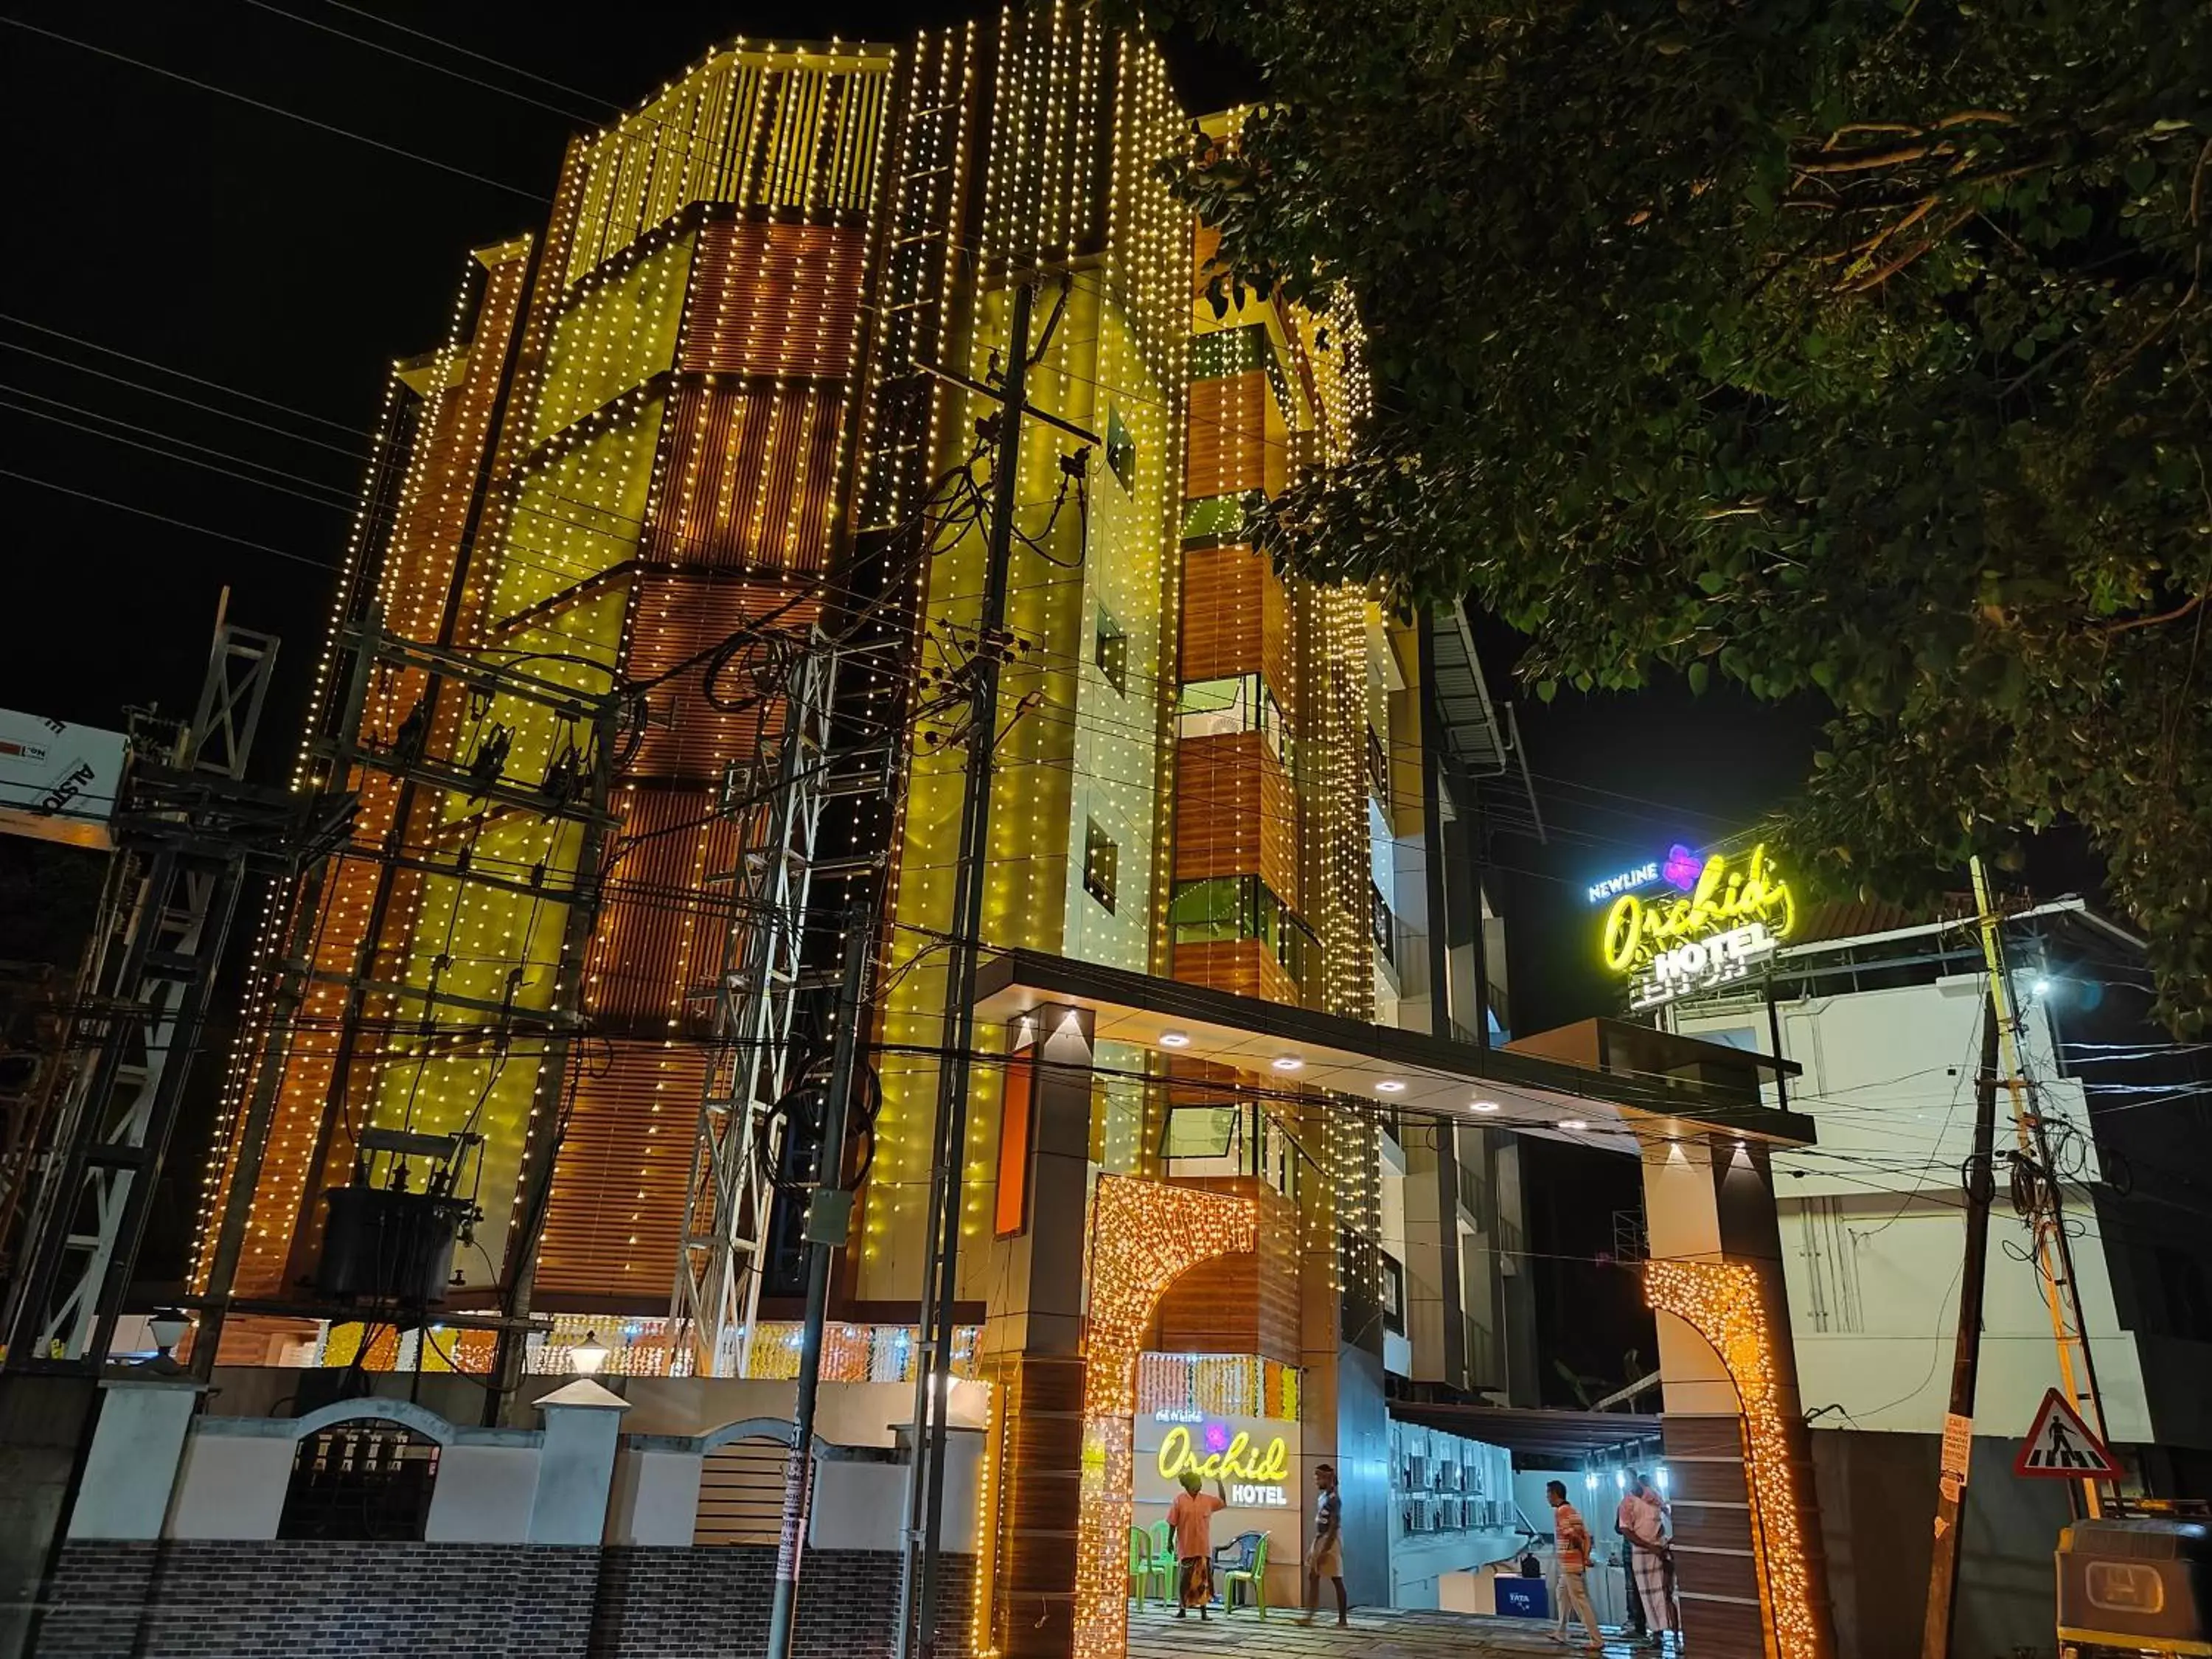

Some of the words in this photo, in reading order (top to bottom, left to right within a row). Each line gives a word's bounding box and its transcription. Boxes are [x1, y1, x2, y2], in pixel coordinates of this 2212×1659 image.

[1588, 862, 1658, 903] NEWLINE
[1604, 843, 1795, 970] Orchid
[1655, 922, 1775, 980] HOTEL
[1158, 1426, 1288, 1481] Orchid
[1232, 1484, 1287, 1506] HOTEL
